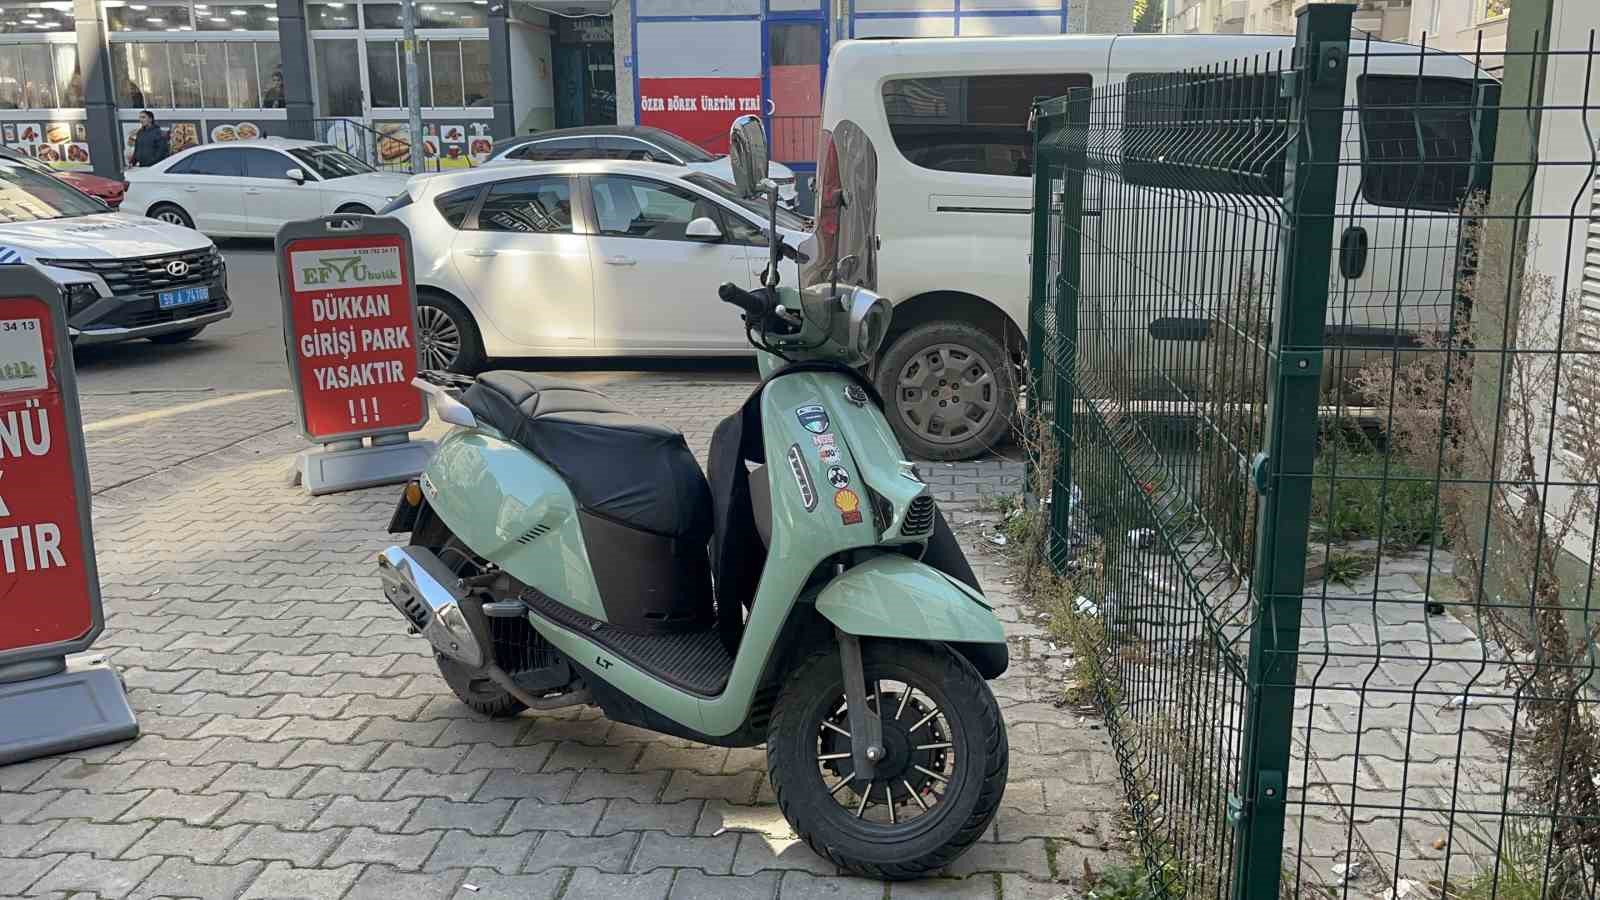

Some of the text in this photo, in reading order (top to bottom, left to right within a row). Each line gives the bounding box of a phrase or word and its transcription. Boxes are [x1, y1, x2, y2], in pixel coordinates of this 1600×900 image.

[641, 95, 761, 111] ÖZER BÖREK ÜRETİM YERİ
[311, 293, 390, 322] DÜKKAN
[3, 321, 35, 331] 34 13
[301, 325, 411, 359] GİRİŞİ PARK
[313, 360, 405, 391] YASAKTIR
[0, 522, 66, 574] TIR
[596, 656, 614, 670] LT
